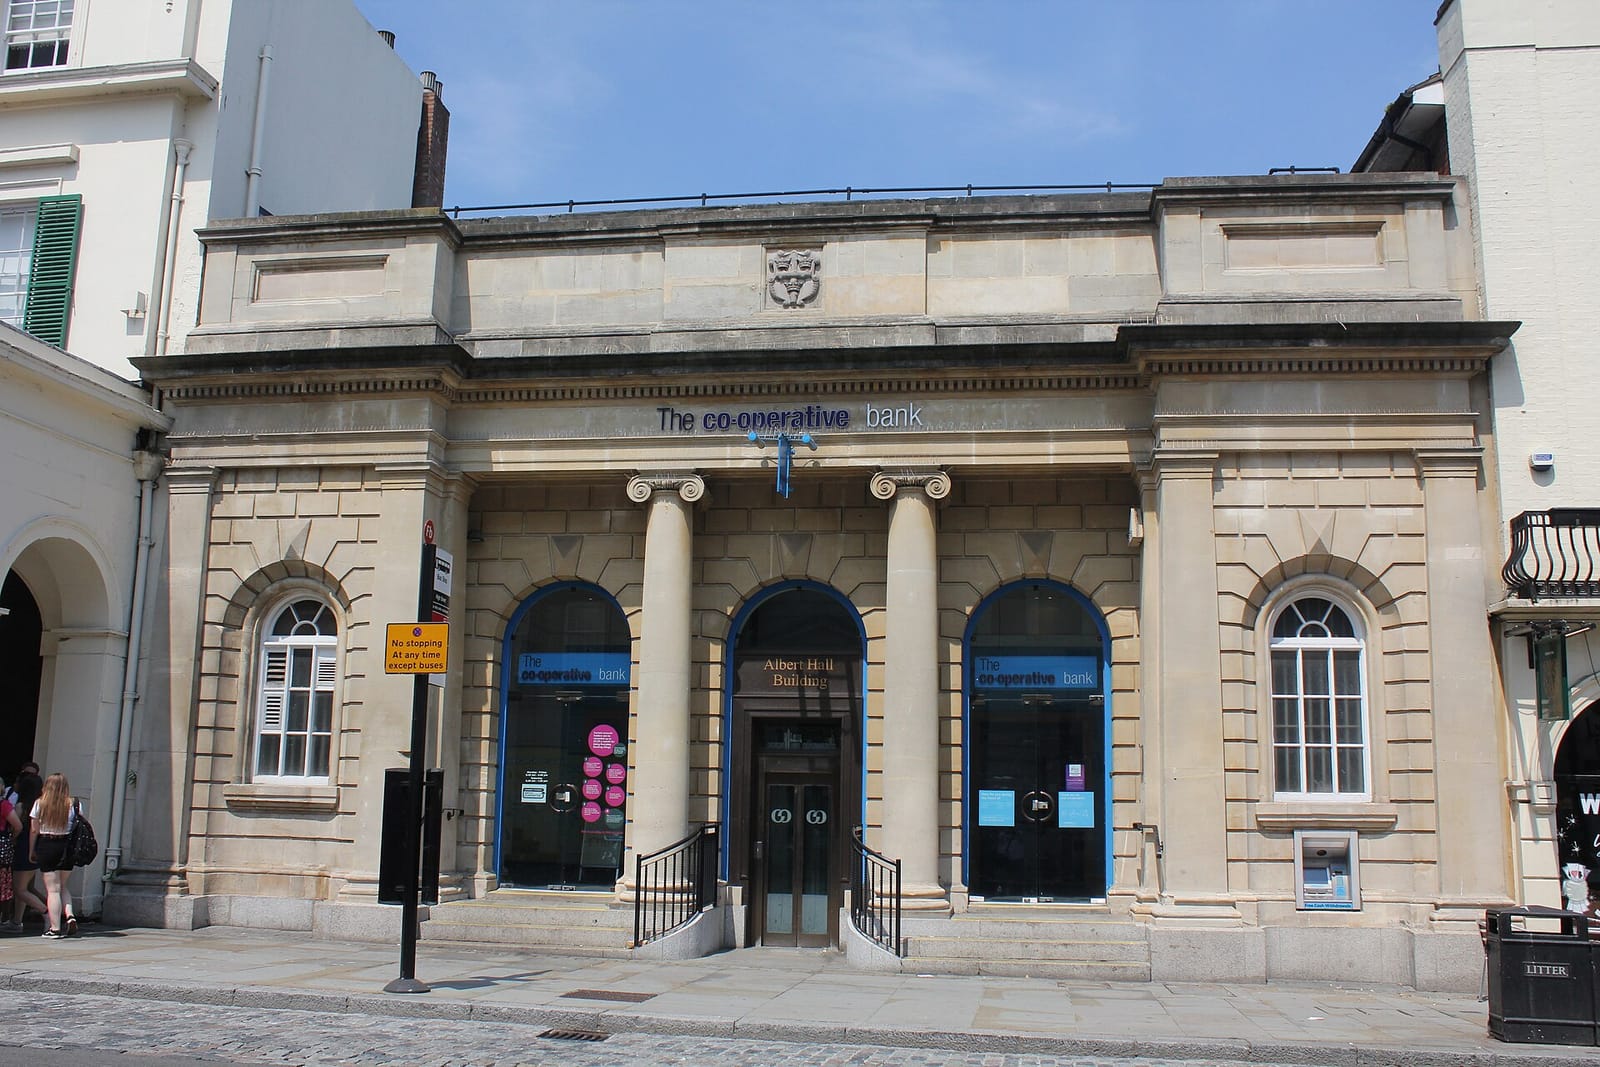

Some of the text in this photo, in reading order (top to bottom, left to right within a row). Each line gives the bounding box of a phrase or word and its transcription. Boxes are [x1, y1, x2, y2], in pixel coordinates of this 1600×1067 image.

[657, 402, 923, 434] The co-operative bank
[406, 640, 443, 648] stopping
[524, 655, 541, 667] The
[764, 658, 833, 671] Albert Hall
[980, 658, 1000, 671] The
[522, 668, 626, 682] co-operative bank
[773, 673, 828, 689] Building
[979, 671, 1093, 686] co-operative bank
[1526, 965, 1567, 976] LITTER
